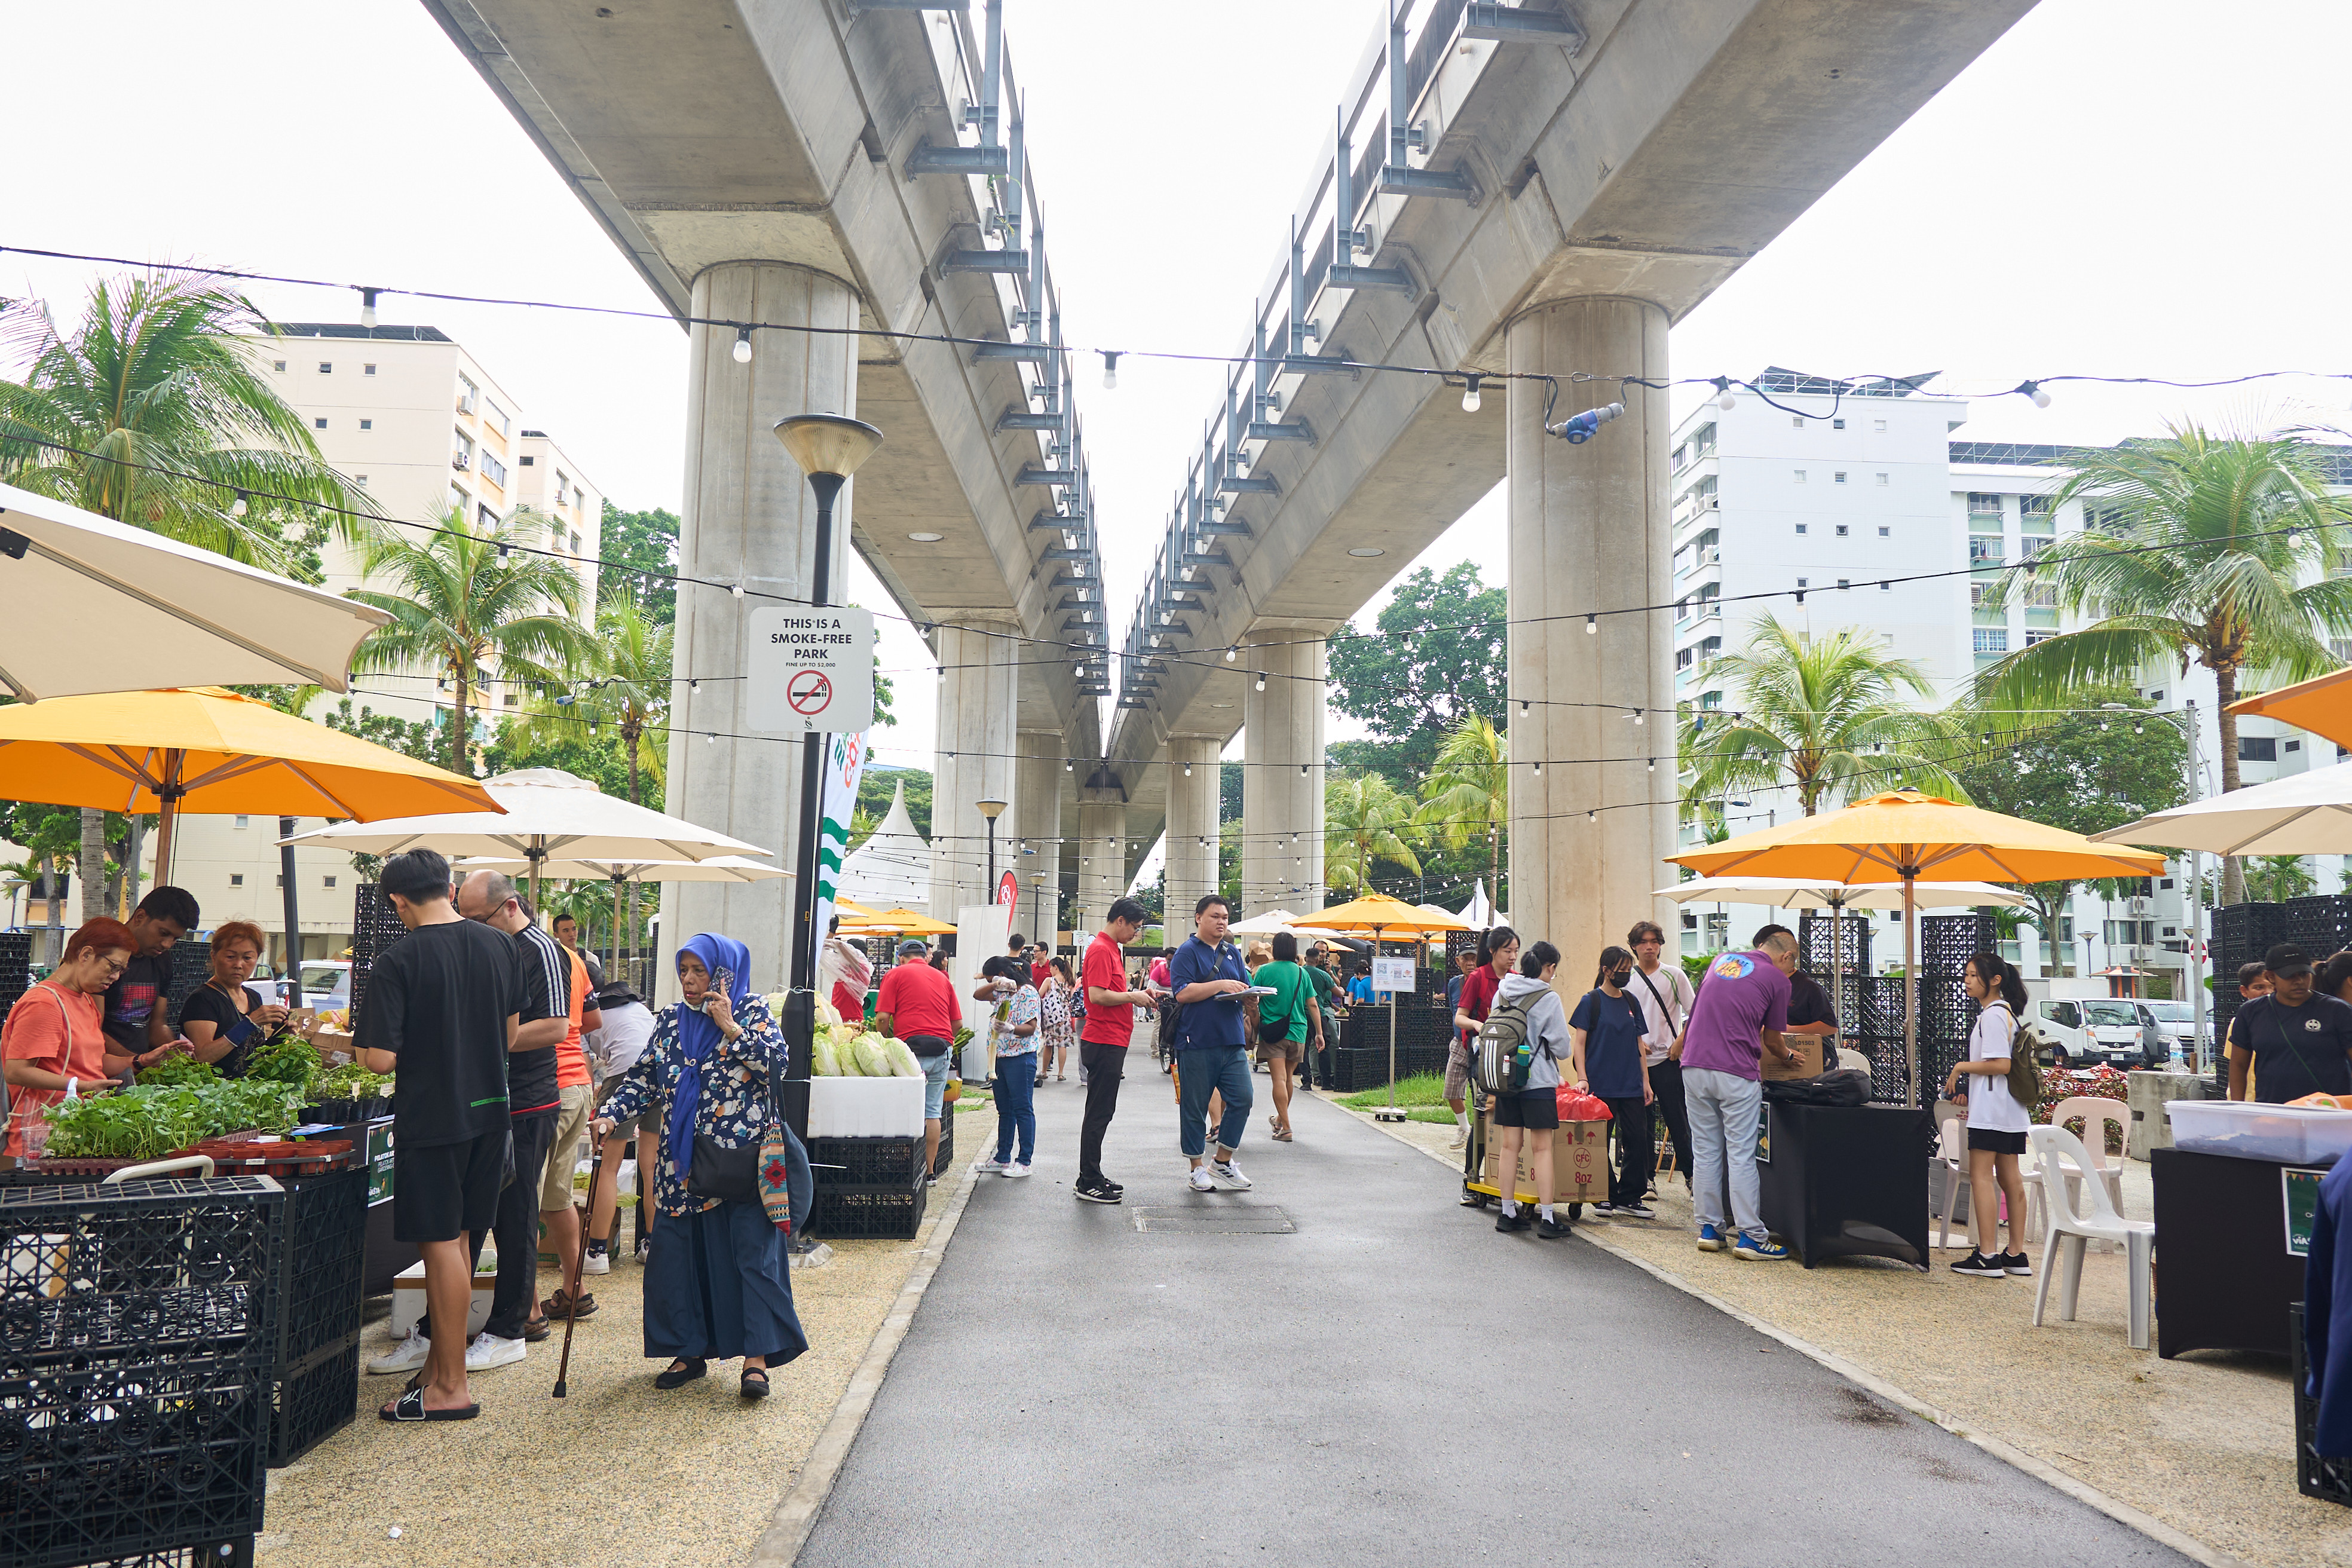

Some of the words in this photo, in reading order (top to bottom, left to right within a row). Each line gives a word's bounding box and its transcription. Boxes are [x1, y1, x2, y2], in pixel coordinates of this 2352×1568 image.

[783, 618, 812, 629] THIS
[816, 618, 828, 629] IS
[831, 619, 841, 629] A
[771, 633, 852, 644] SMOKE-FREE
[794, 649, 828, 659] PARK
[1576, 1154, 1590, 1163] CFC
